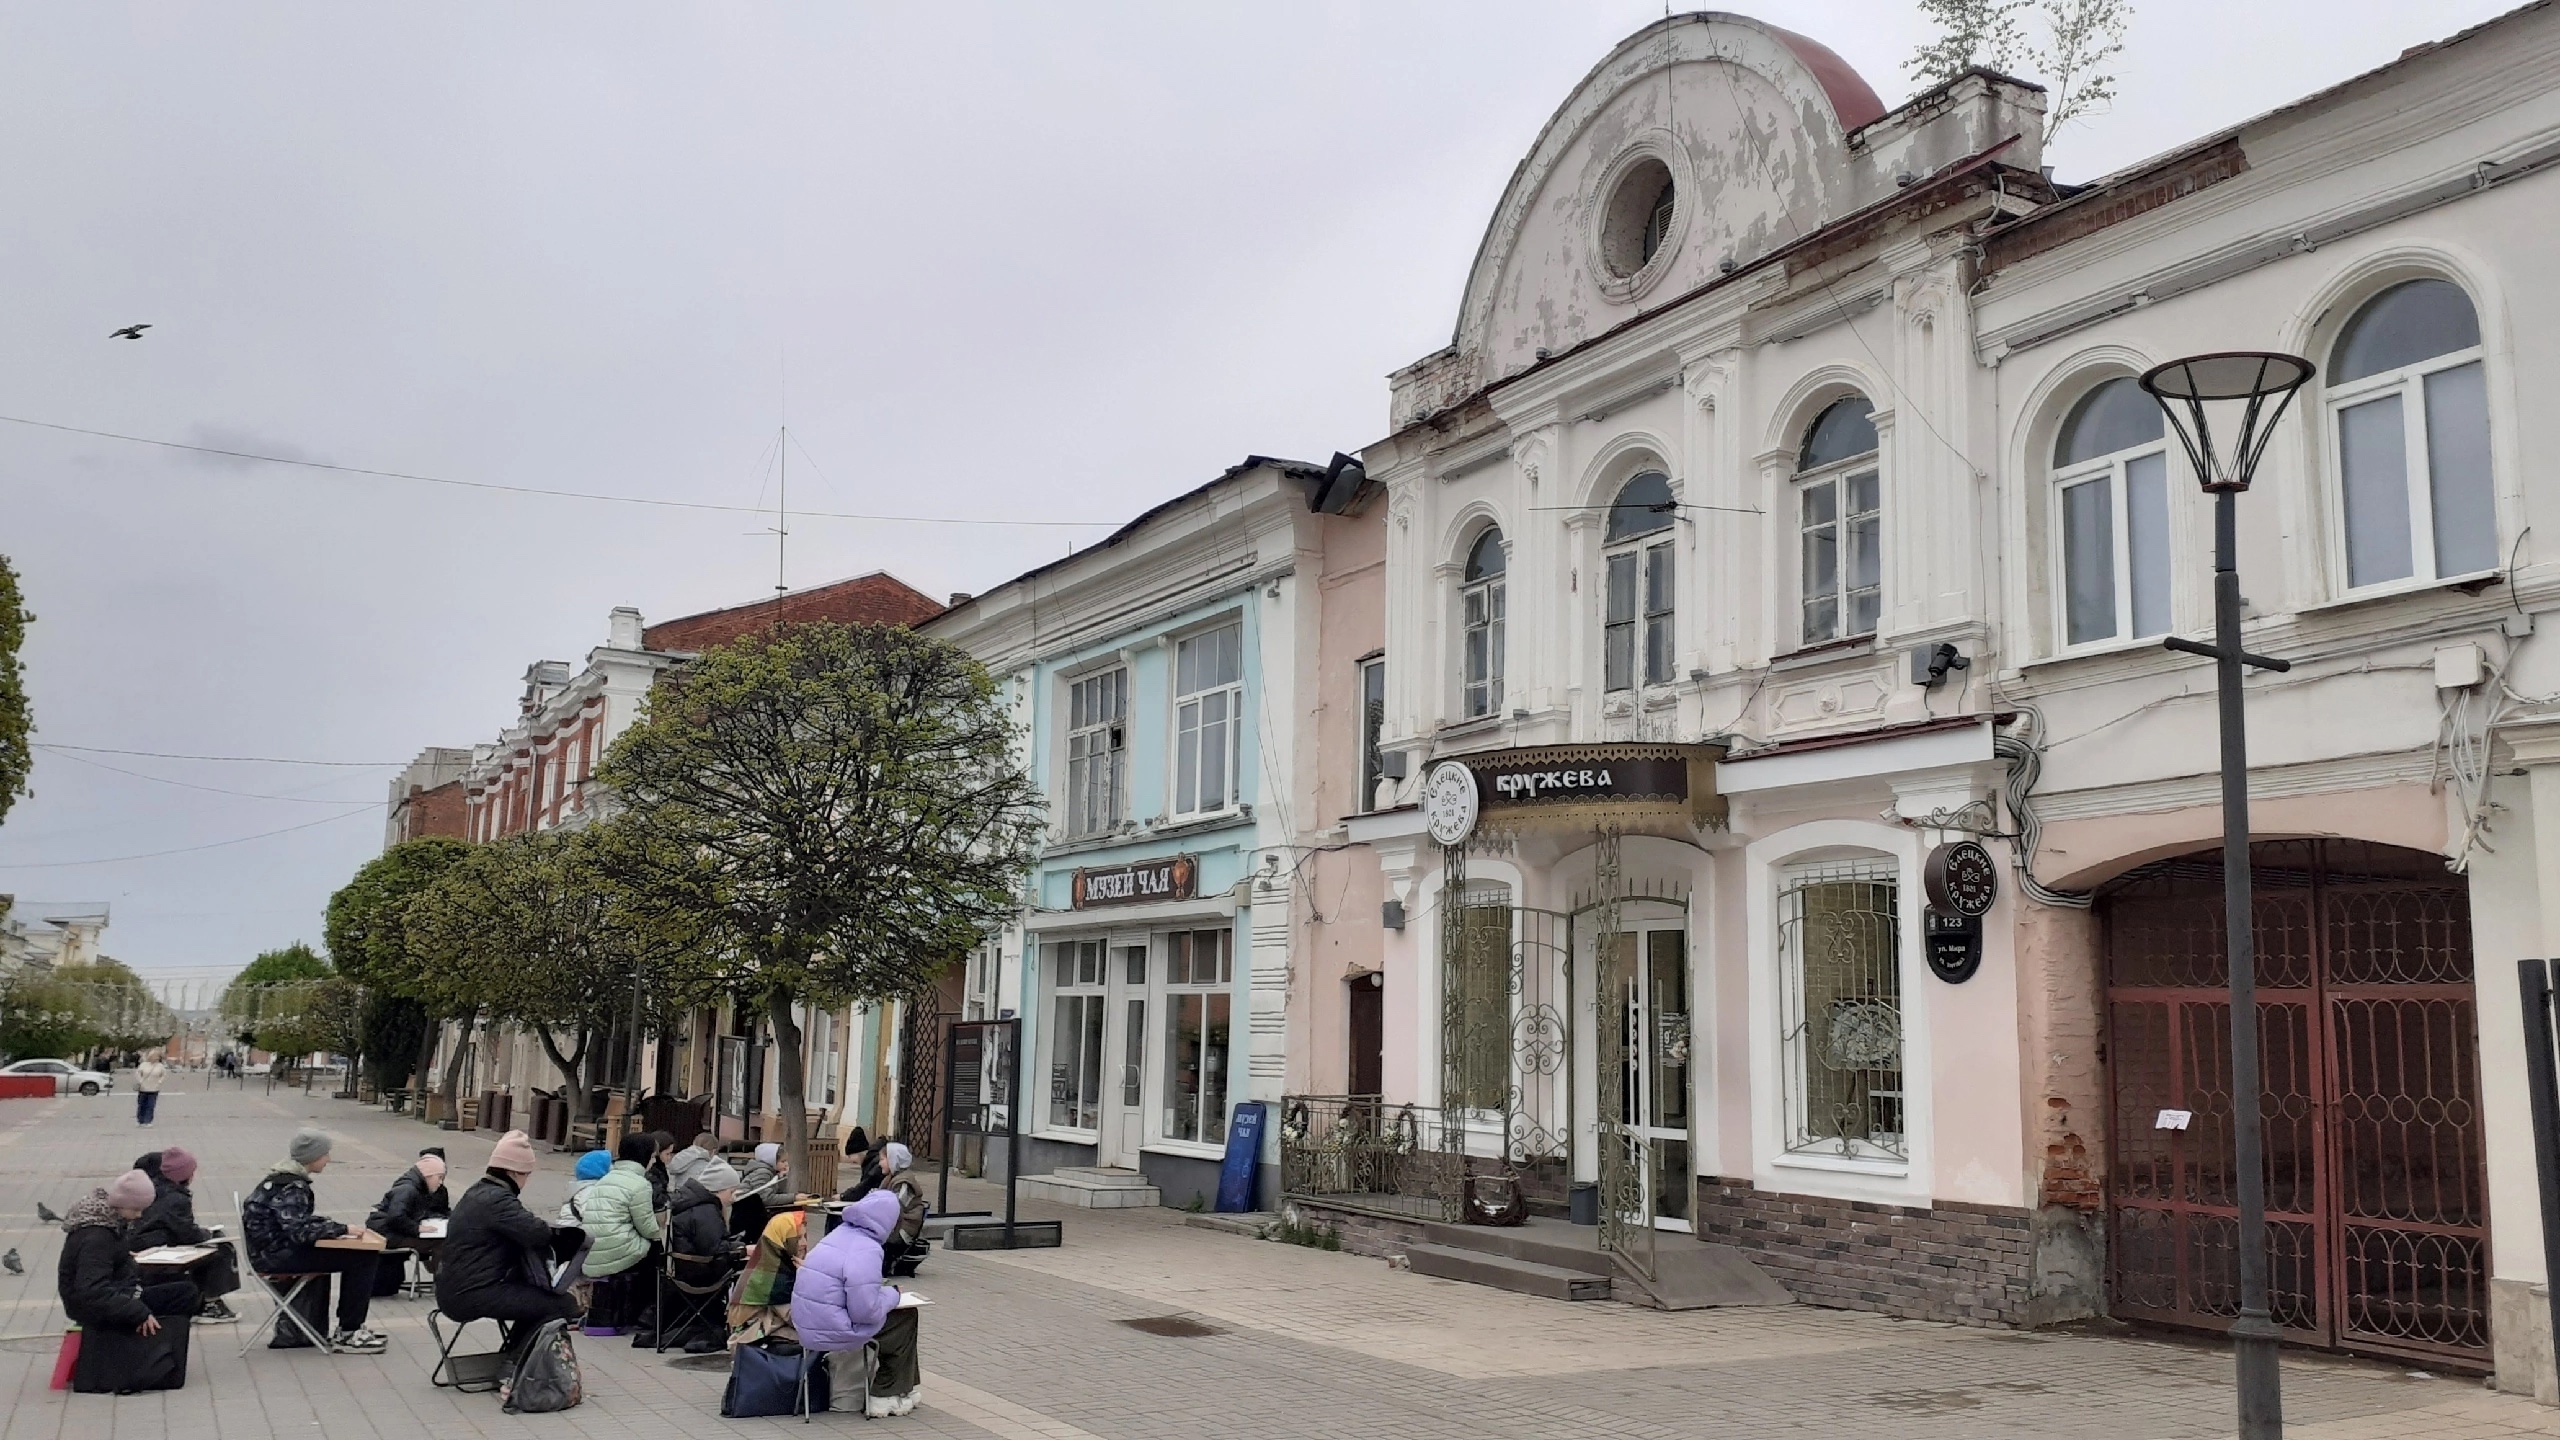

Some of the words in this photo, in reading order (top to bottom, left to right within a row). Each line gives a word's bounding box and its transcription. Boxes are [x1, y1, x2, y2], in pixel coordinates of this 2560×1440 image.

[1085, 867, 1135, 900] МУЗЕЙ
[1137, 867, 1170, 894] ЧАЯ
[1943, 918, 1963, 927] 123
